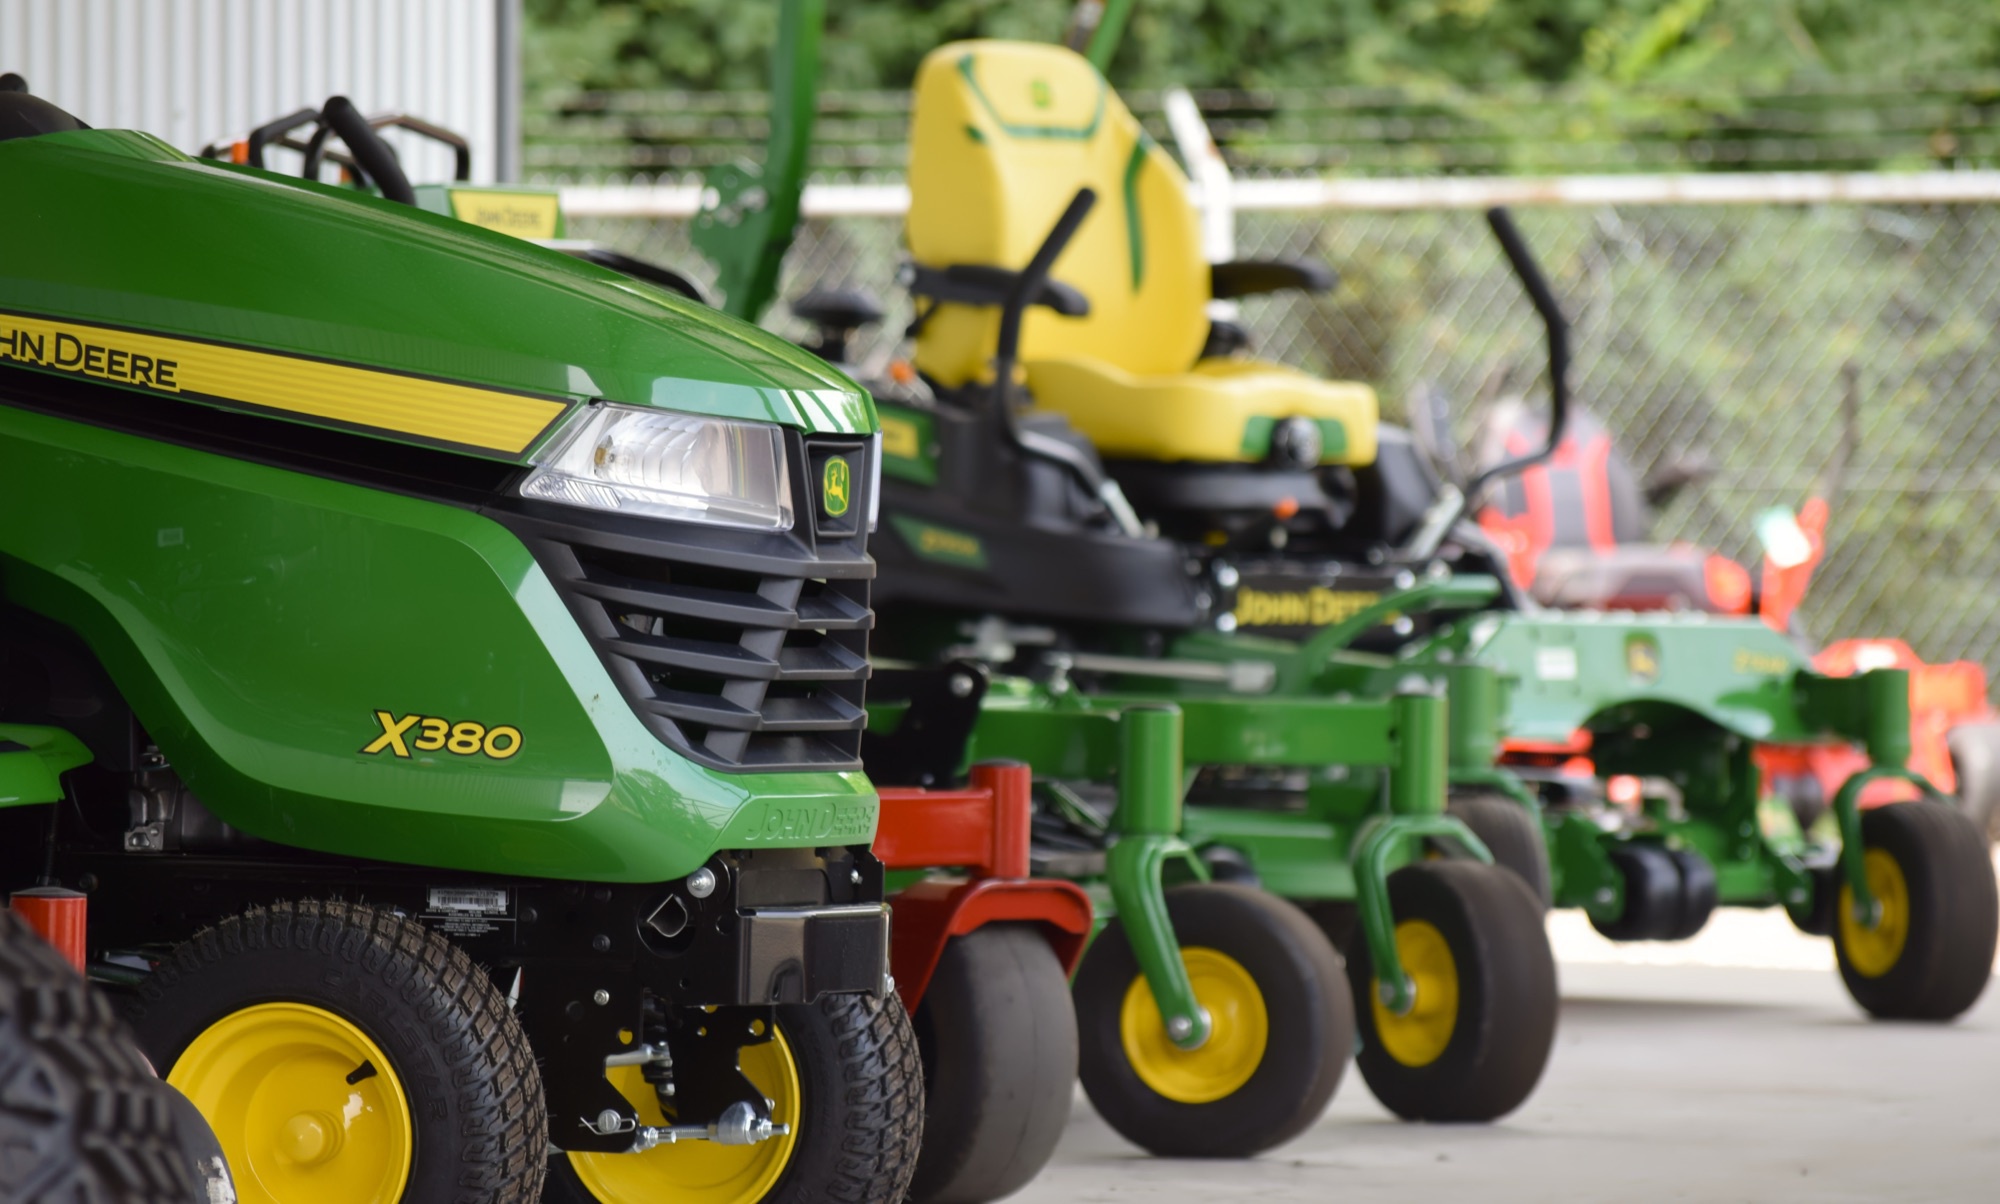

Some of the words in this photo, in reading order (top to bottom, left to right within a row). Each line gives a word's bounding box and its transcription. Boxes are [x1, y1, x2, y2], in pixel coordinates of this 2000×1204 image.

[55, 332, 178, 388] DEERE
[1235, 587, 1309, 626] JOHN
[359, 710, 523, 759] X380
[745, 803, 817, 840] JOHN
